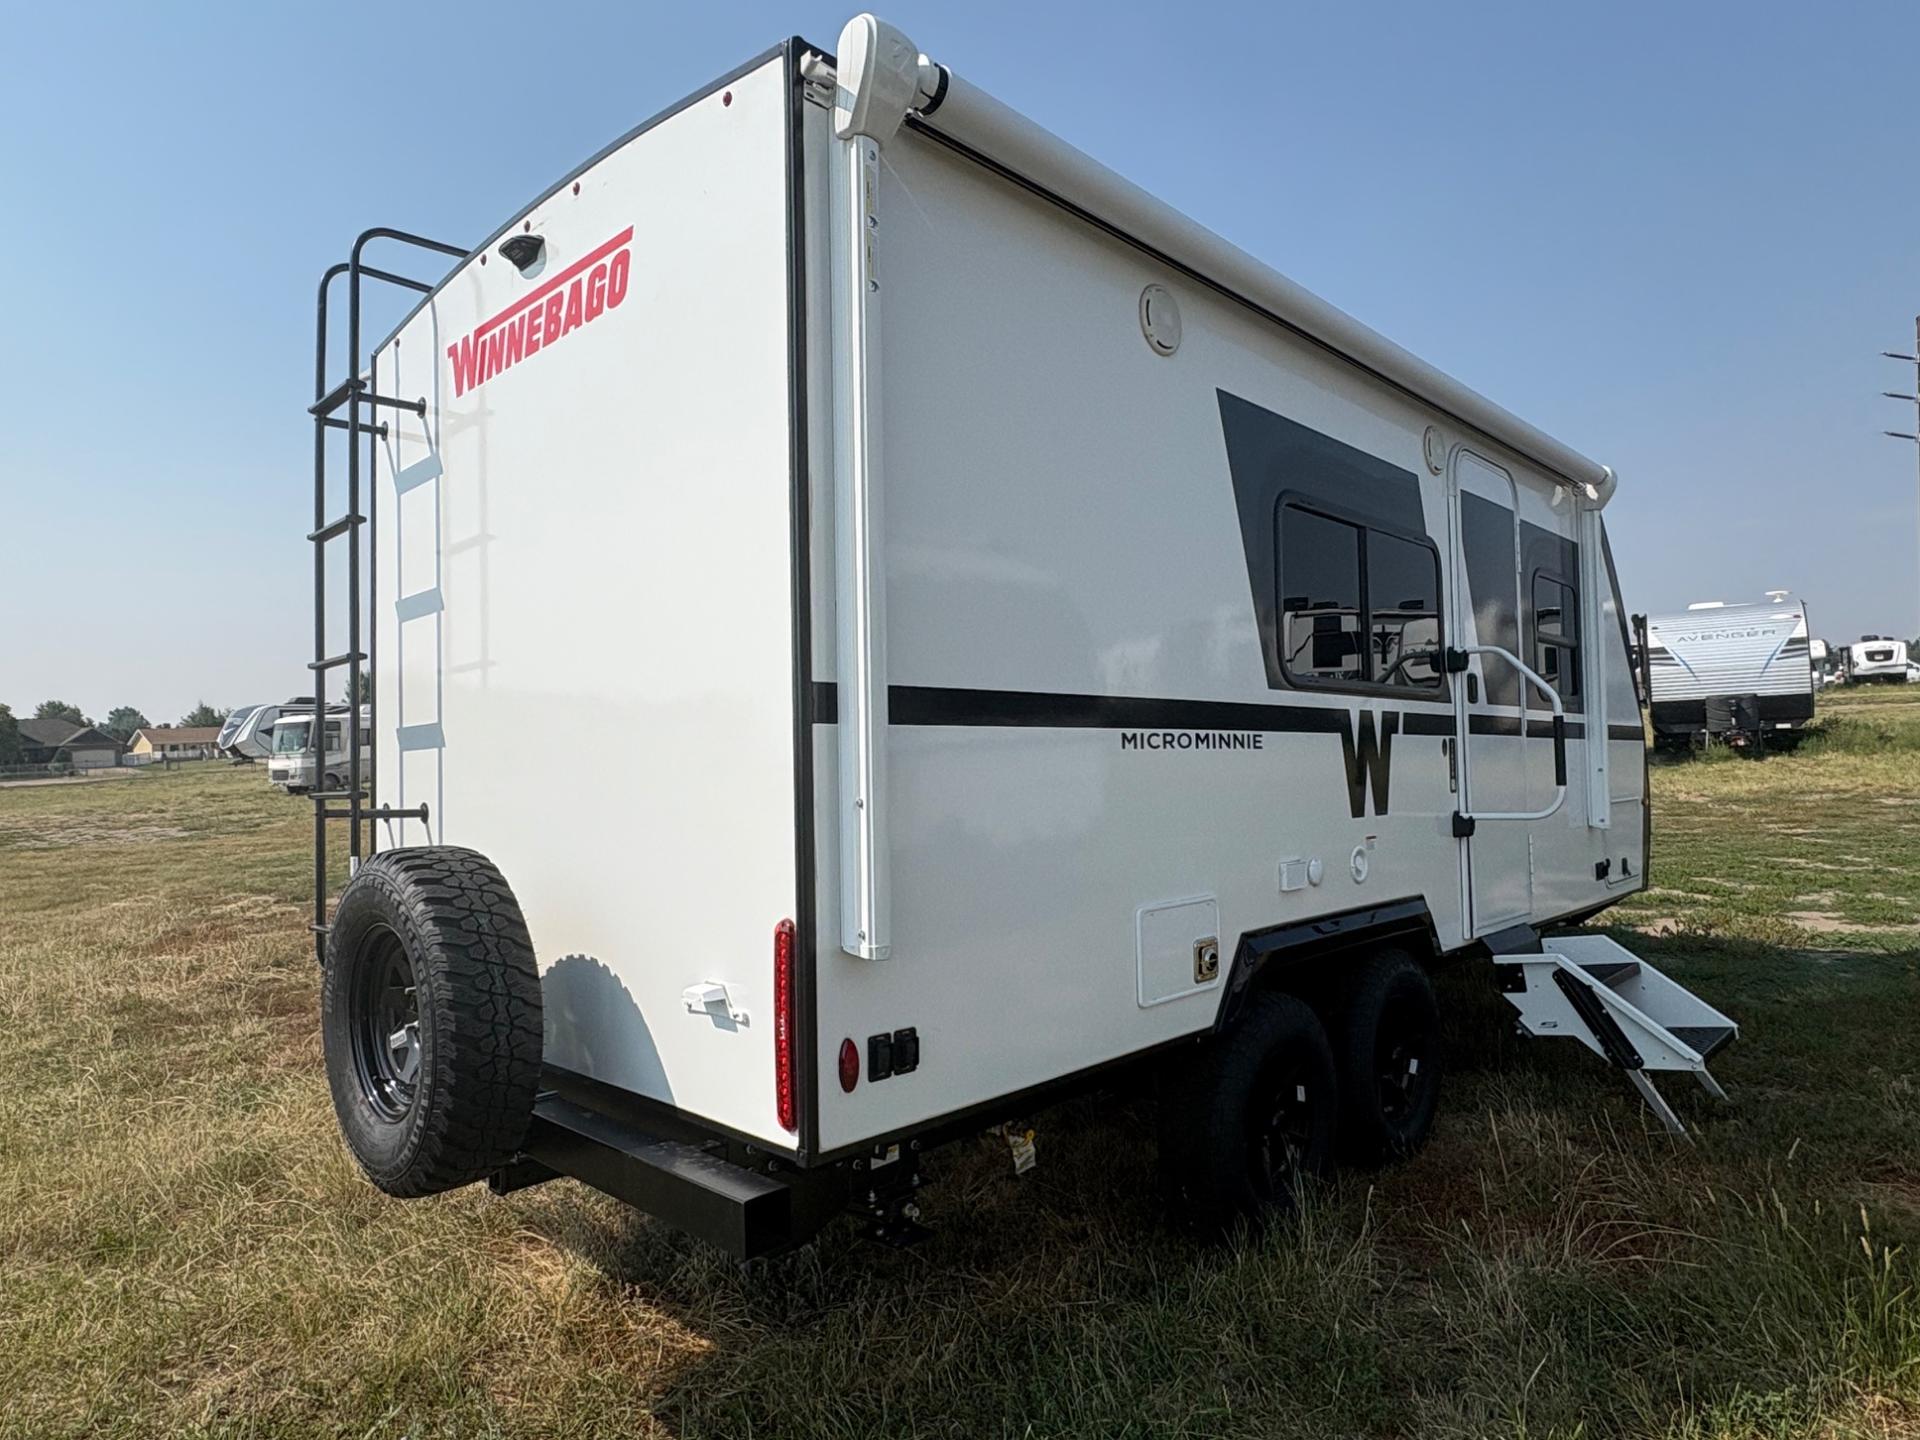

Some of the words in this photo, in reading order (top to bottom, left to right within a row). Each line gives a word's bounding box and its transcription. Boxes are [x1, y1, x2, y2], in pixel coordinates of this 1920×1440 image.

[447, 225, 634, 398] WINNEBAGO
[1677, 628, 1776, 642] AVENGER
[1121, 732, 1263, 750] MICROMINNIE
